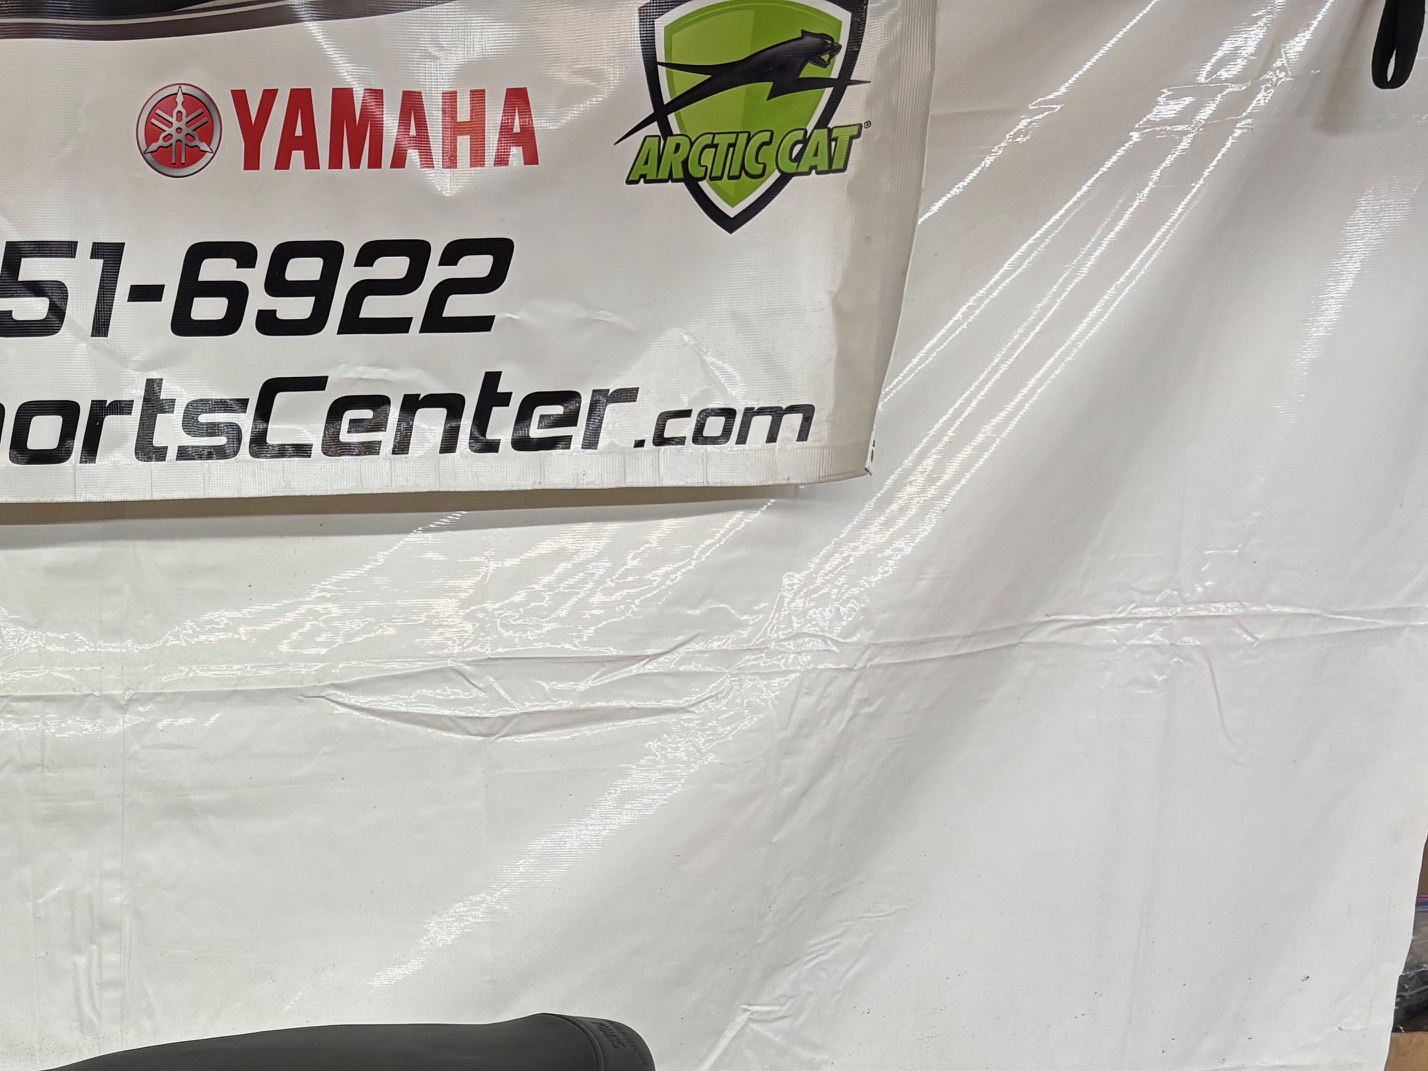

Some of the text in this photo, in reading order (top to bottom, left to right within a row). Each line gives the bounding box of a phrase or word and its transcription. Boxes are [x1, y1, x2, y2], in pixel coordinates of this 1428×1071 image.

[230, 87, 540, 171] YAMAHA
[625, 123, 864, 185] ARCTIC CAT
